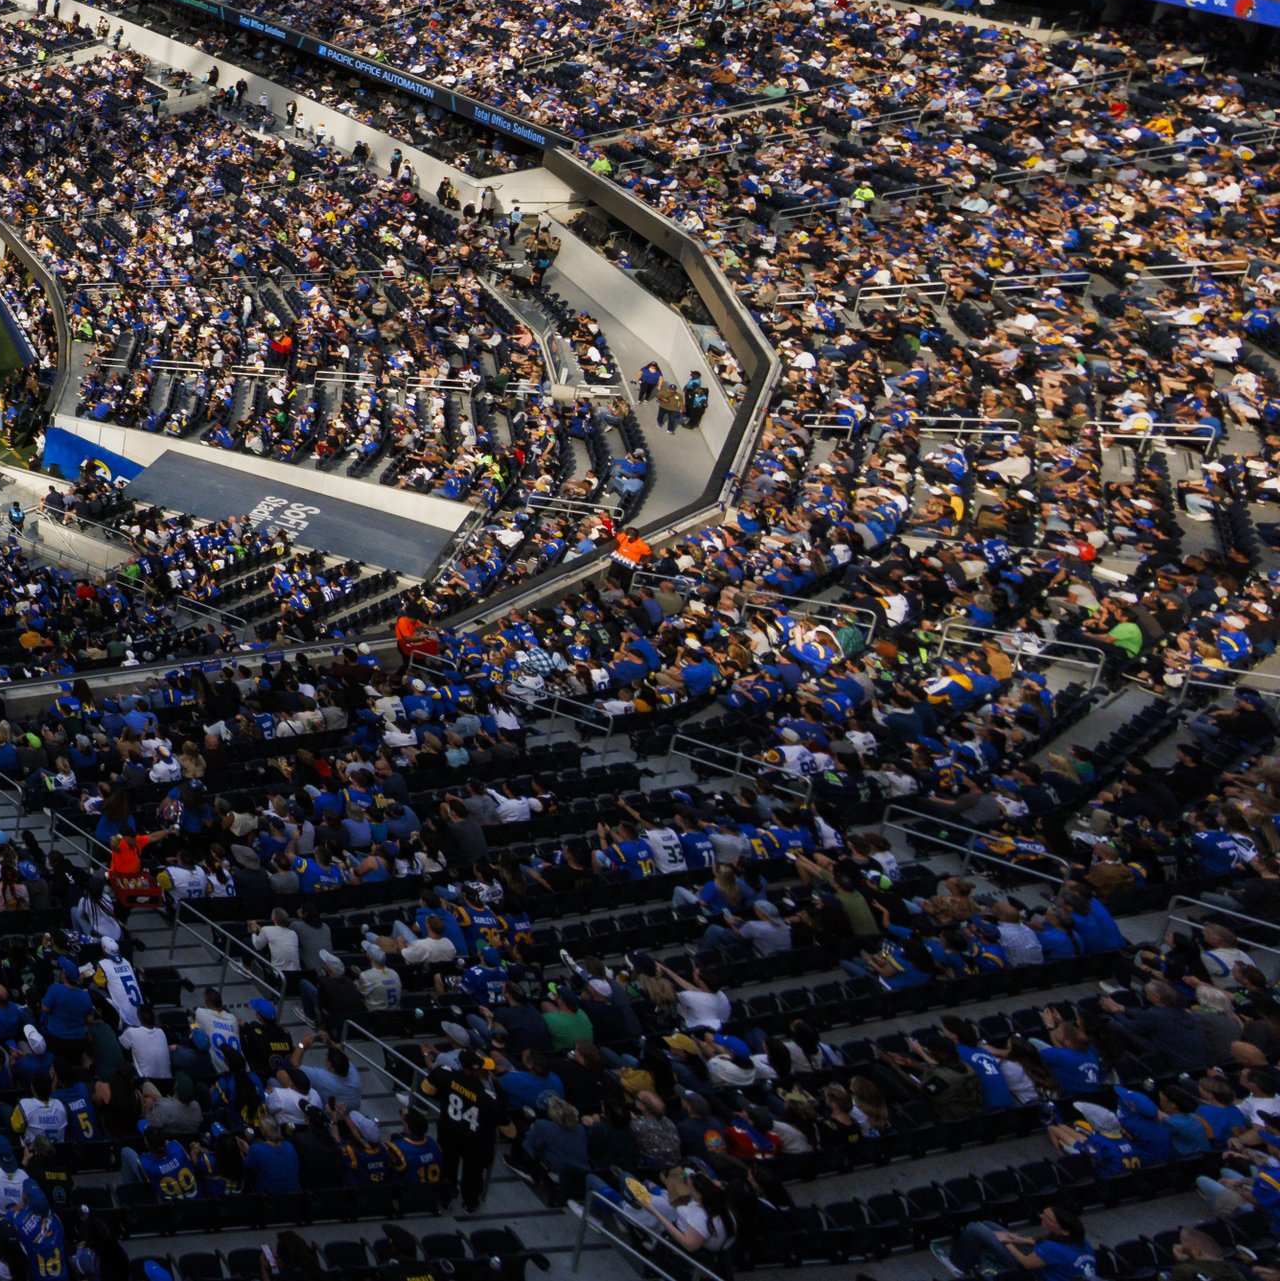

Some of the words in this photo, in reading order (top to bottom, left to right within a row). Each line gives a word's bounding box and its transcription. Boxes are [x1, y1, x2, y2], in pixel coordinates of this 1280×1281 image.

[327, 49, 354, 67] PACIFIC
[355, 60, 381, 77] OFFICE
[382, 71, 435, 99] AUTOMATION
[474, 107, 490, 122] Total
[491, 114, 511, 131] Office
[512, 123, 546, 145] Solutions
[274, 502, 320, 532] SoFi
[123, 975, 140, 1008] 5
[386, 989, 397, 1007] 5
[450, 1080, 478, 1103] BROWN
[77, 1113, 95, 1139] 5
[448, 1092, 479, 1133] 84
[159, 1168, 198, 1199] 99
